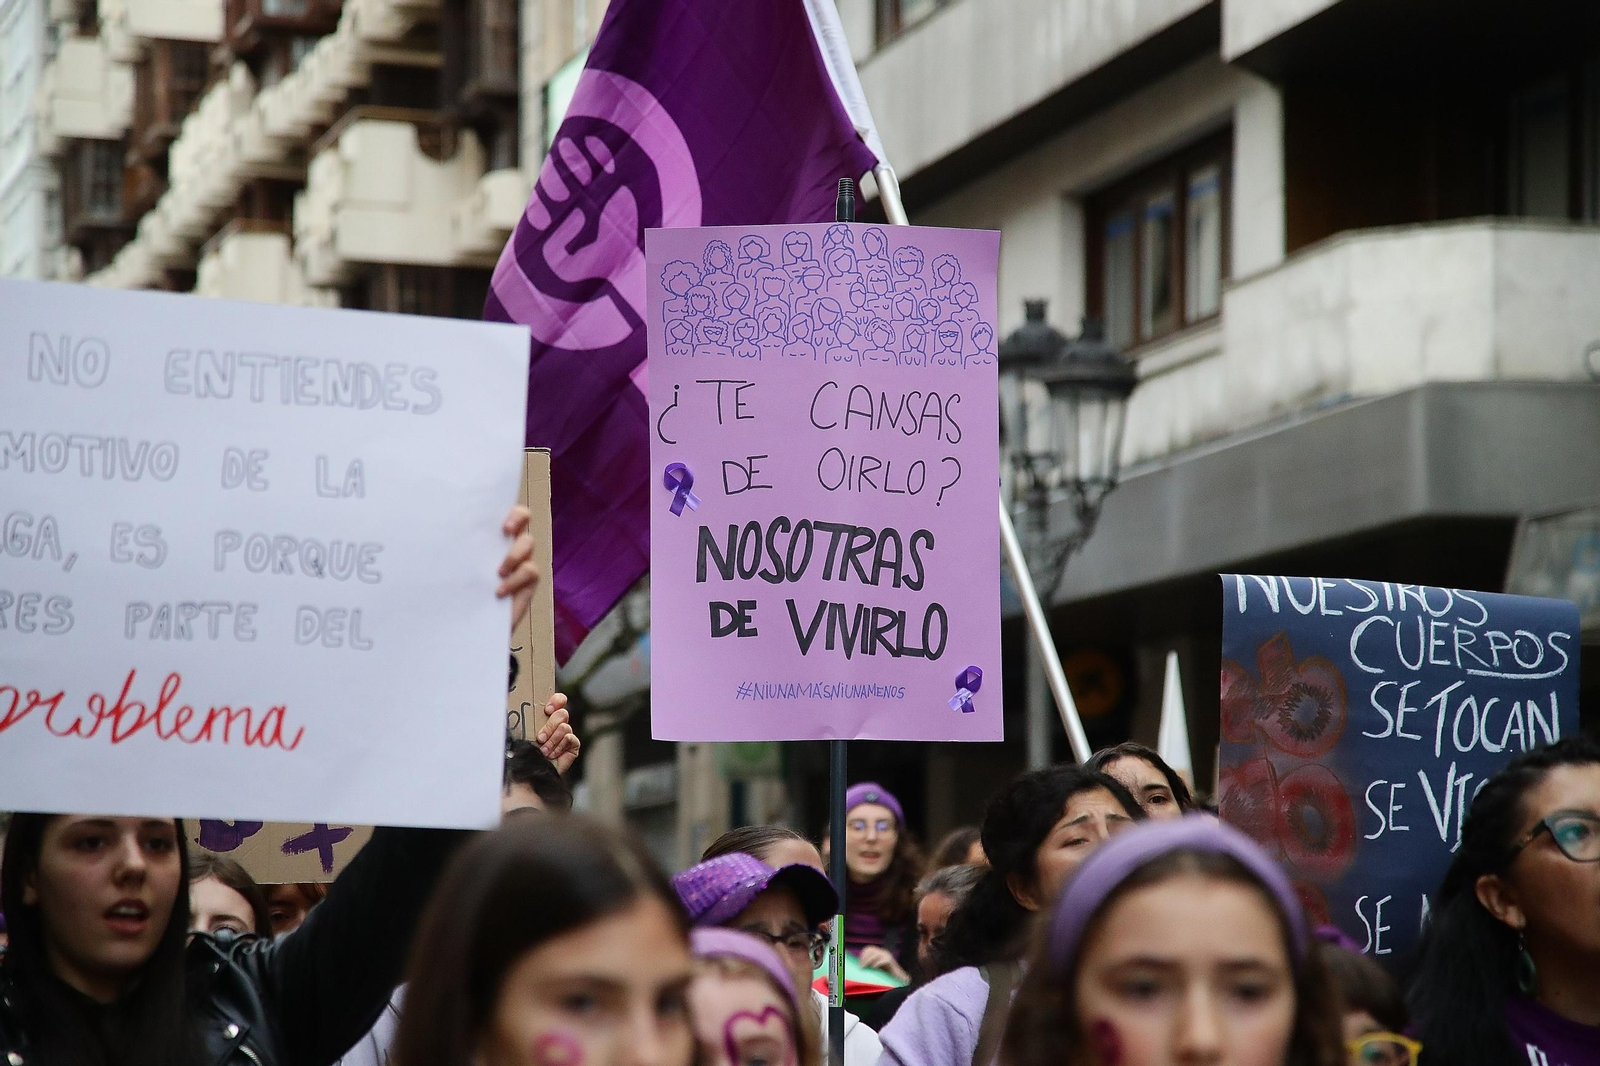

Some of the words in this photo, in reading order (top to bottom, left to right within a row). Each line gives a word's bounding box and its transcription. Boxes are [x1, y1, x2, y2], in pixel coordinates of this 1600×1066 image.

[27, 332, 111, 389] NO
[163, 349, 443, 416] ENTIENDES
[810, 381, 962, 444] CANSAS
[0, 431, 179, 482] MOTIVO
[221, 448, 269, 491] DE
[316, 454, 366, 499] LA
[721, 454, 773, 495] DE
[817, 447, 962, 507] OIRLO?
[0, 511, 78, 572] GA,
[110, 522, 168, 569] ES
[214, 530, 384, 584] PORQUE
[696, 516, 934, 591] NOSOTRAS
[124, 601, 258, 643] PARTE
[294, 607, 374, 651] DEL
[709, 600, 758, 638] DE
[785, 599, 949, 661] VIVIRLO
[1350, 615, 1571, 679] CUERPOS
[1362, 680, 1422, 741] SE
[1424, 680, 1560, 758] TOCAN
[1364, 780, 1410, 840] SE
[1355, 894, 1392, 955] SE
